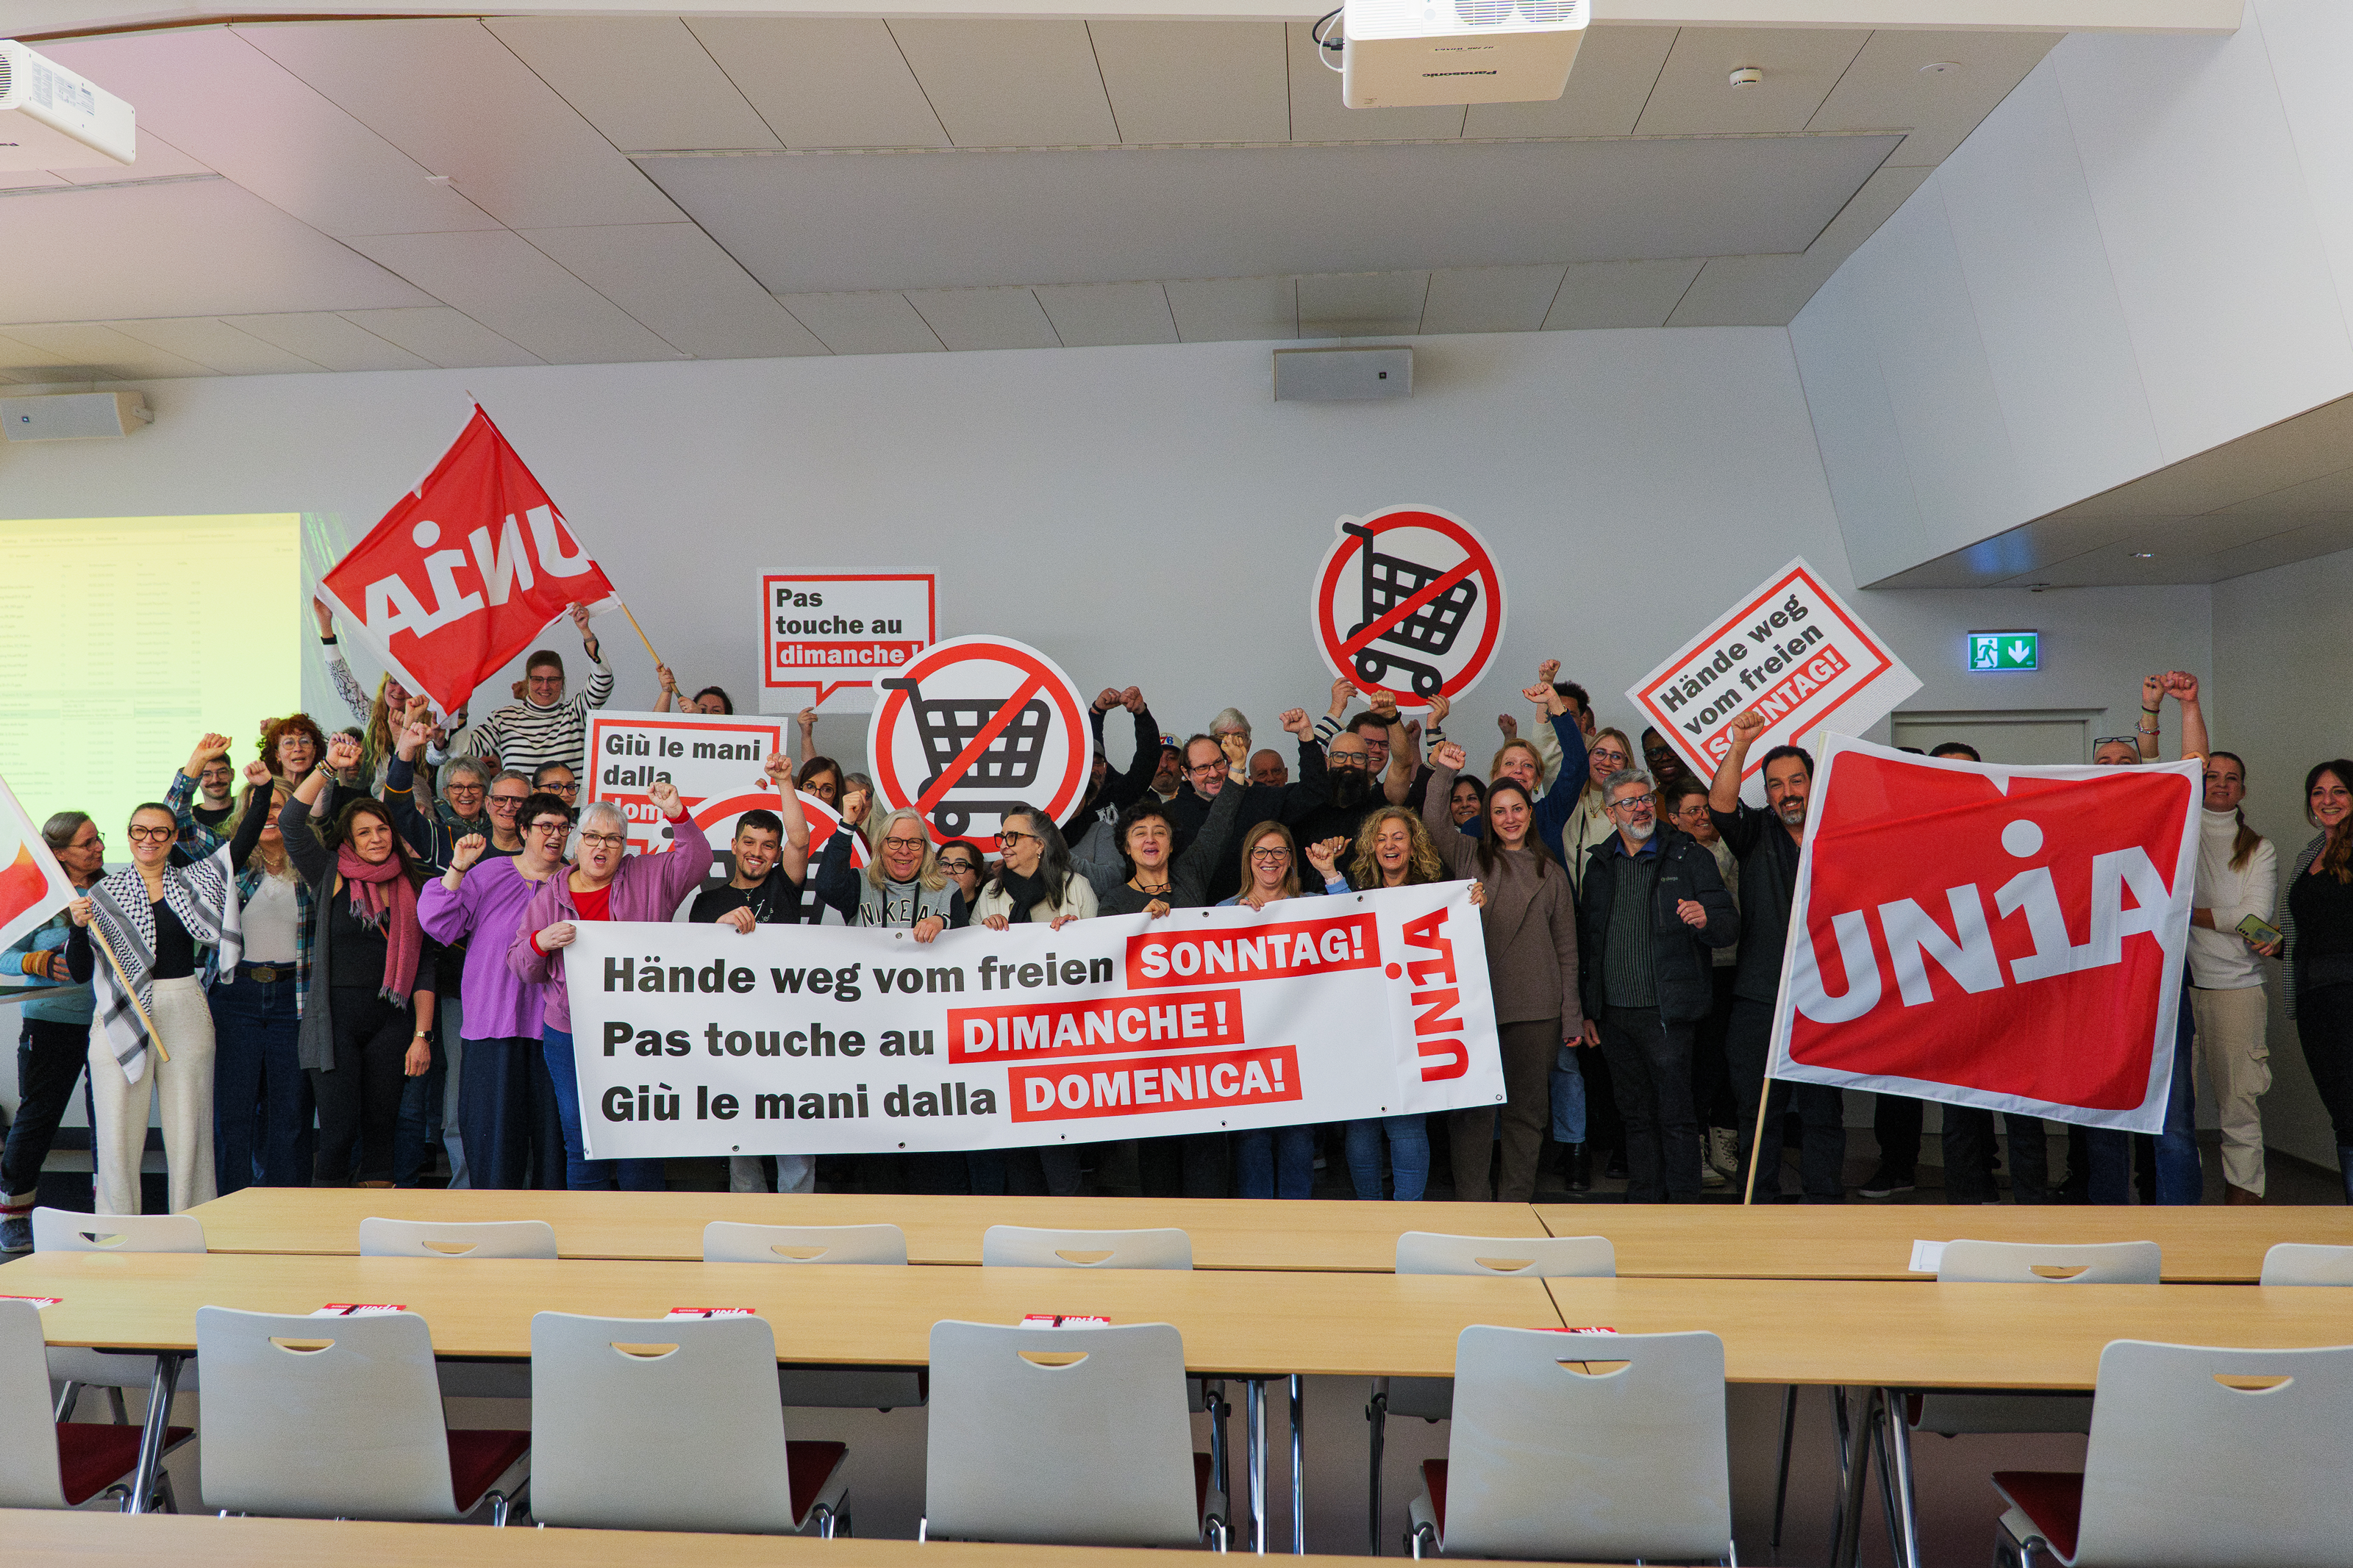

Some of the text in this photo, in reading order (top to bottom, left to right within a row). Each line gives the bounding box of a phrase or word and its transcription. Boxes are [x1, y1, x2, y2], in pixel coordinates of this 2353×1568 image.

[776, 589, 823, 607] Pas
[776, 616, 902, 634] touche au
[780, 645, 904, 665] dimanche
[1660, 594, 1809, 713] Hände weg
[1683, 624, 1824, 735] vom freien
[606, 734, 760, 762] Giù le mani
[604, 765, 672, 787] dalla
[860, 898, 912, 928] NIKE
[604, 926, 1365, 1003] Hände weg vom freien SONNTAG!
[603, 1022, 692, 1057] Pas
[704, 1023, 866, 1057] touche
[880, 1030, 935, 1056] au
[601, 1059, 1288, 1123] Giù le mani dalla DOMENICA!
